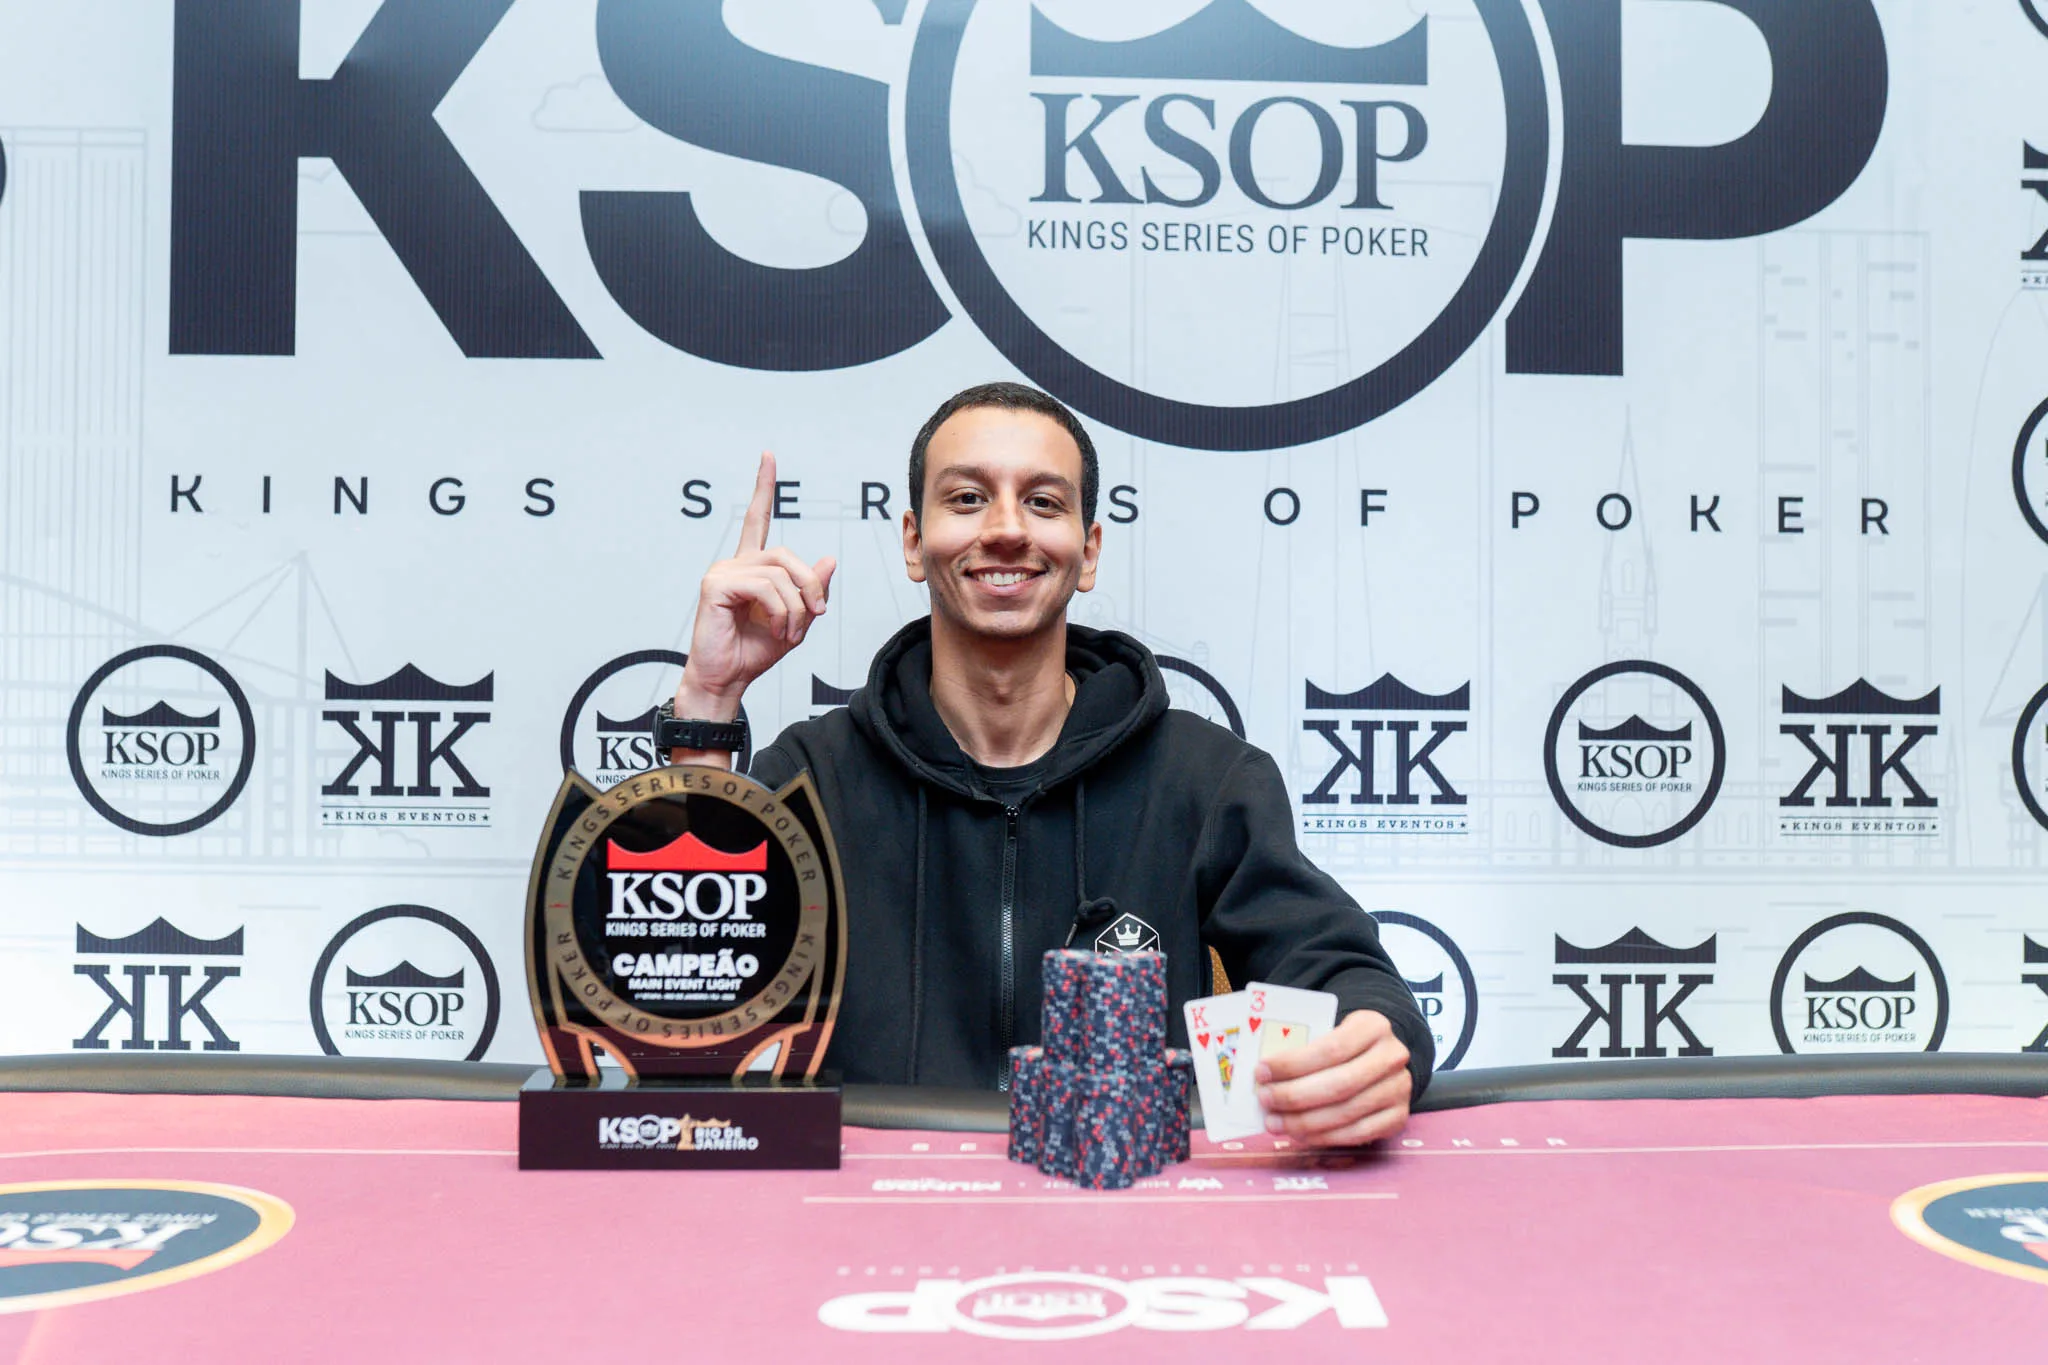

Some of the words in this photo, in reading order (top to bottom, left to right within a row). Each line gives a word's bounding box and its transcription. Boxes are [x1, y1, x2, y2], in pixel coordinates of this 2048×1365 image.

[1029, 92, 1429, 211] KSOP
[1028, 219, 1129, 251] KINGS
[1141, 222, 1254, 254] SERIES
[1267, 225, 1309, 254] OF
[1321, 227, 1429, 257] POKER
[170, 474, 557, 518] KINGS
[680, 479, 1139, 525] SERS
[1263, 487, 1388, 527] OF
[1511, 491, 1890, 536] POKER
[103, 731, 220, 766] KSOP
[596, 736, 666, 772] KS
[1578, 744, 1692, 779] KSOP
[101, 769, 132, 780] KINGS
[134, 769, 168, 780] SERIES
[170, 769, 185, 780] OF
[187, 769, 220, 780] POKER
[1577, 782, 1607, 793] KINGS
[1609, 782, 1643, 793] SERIES
[1645, 782, 1658, 793] OF
[1660, 782, 1692, 793] POKER
[335, 811, 388, 821] KINGS
[397, 812, 477, 822] EVENTOS
[557, 803, 612, 882] KINGS
[615, 773, 712, 808] SERIES
[724, 780, 757, 804] OF
[760, 802, 817, 883] POKER
[1316, 819, 1368, 829] KINGS
[1377, 819, 1454, 829] EVENTOS
[1792, 822, 1842, 831] KINGS
[1851, 821, 1926, 831] EVENTOS
[605, 872, 768, 920] KSOP
[605, 922, 648, 938] KINGS
[650, 923, 698, 938] SERIES
[699, 923, 719, 938] OF
[720, 923, 767, 938] POKER
[612, 948, 760, 978] CAMPEÃO
[628, 977, 663, 991] MAIN
[664, 977, 705, 991] EVENT
[706, 978, 743, 991] LIGHT
[346, 991, 465, 1027] KSOP
[1250, 990, 1266, 1012] 3
[1805, 995, 1916, 1030] KSOP
[1191, 1006, 1208, 1030] K
[344, 1029, 376, 1041] KINGS
[378, 1029, 413, 1041] SERIES
[414, 1029, 427, 1041] OF
[430, 1029, 465, 1041] POKER
[1803, 1032, 1832, 1043] KINGS
[1834, 1032, 1868, 1043] SERIES
[1869, 1032, 1882, 1043] OF
[1884, 1032, 1916, 1043] POKER
[599, 1114, 681, 1146] KSOP
[818, 1270, 1390, 1342] KSOP
